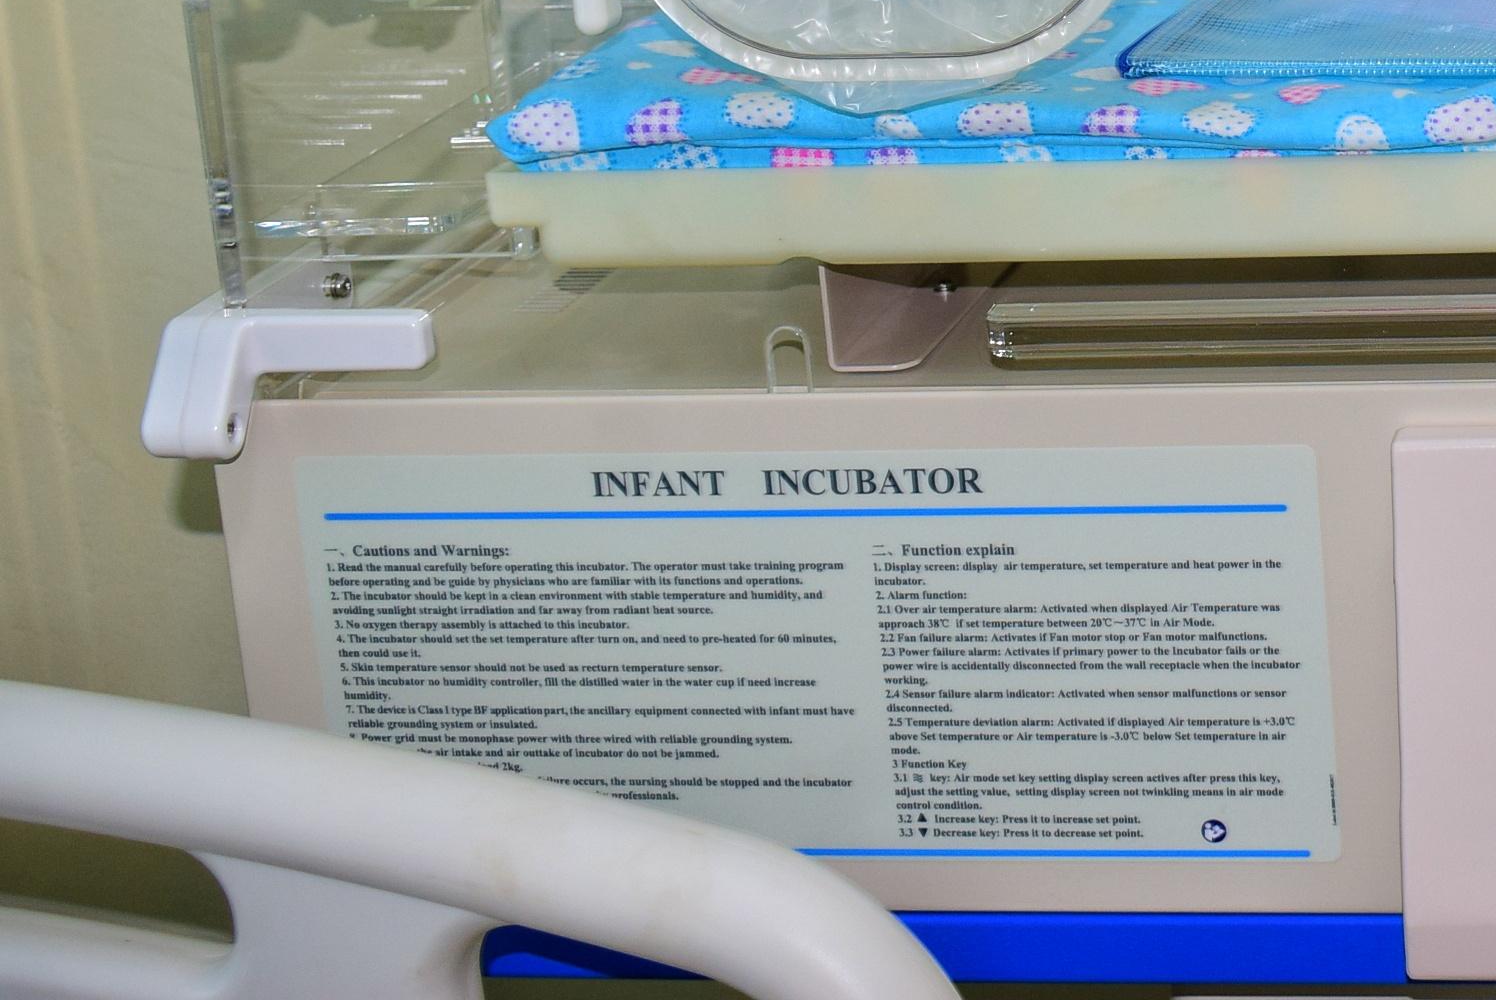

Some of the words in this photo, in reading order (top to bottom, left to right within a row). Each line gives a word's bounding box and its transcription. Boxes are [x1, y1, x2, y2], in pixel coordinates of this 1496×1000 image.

[592, 470, 724, 497] INFANT
[762, 468, 983, 496] INCUBATOR
[353, 545, 411, 557] Cautions
[413, 545, 438, 556] and
[441, 545, 510, 560] Warnings:
[902, 544, 962, 556] Function
[966, 544, 1015, 559] explain
[336, 563, 365, 572] Read
[364, 562, 383, 572] the
[382, 563, 423, 572] manual
[422, 562, 469, 574] carefully
[470, 562, 504, 572] before
[504, 562, 554, 574] operating
[555, 562, 575, 572] this
[576, 562, 629, 572] incubator.
[631, 562, 652, 571] The
[654, 563, 699, 574] operator
[701, 563, 728, 571] must
[729, 561, 752, 570] take
[754, 561, 797, 572] training
[798, 563, 844, 572] program
[884, 562, 922, 574] Display
[962, 562, 998, 573] display
[1004, 562, 1019, 571] air
[1020, 562, 1087, 573] temperature,
[1105, 561, 1169, 572] temperature
[1171, 560, 1191, 569] and
[1193, 560, 1216, 569] heat
[1218, 562, 1250, 571] power
[1265, 560, 1282, 568] the
[874, 577, 926, 586] incubator.
[888, 591, 920, 600] Alarm
[922, 590, 967, 600] function:
[332, 605, 376, 617] avoiding
[376, 605, 418, 617] sunlight
[418, 606, 459, 617] straight
[460, 606, 515, 615] irradiation
[517, 606, 537, 615] and
[538, 606, 554, 615] far
[556, 608, 583, 617] away
[585, 605, 610, 615] from
[613, 605, 650, 614] radiant
[653, 605, 675, 614] heat
[877, 605, 893, 614] 2.1
[894, 605, 921, 614] Over
[922, 605, 938, 614] air
[939, 606, 1002, 616] temperature
[1004, 604, 1037, 613] alarm:
[1041, 604, 1088, 613] Activated
[1091, 604, 1118, 613] when
[1120, 603, 1170, 615] displayed
[1171, 603, 1189, 613] Air
[1191, 603, 1259, 615] Temperature
[361, 622, 398, 632] oxygen
[398, 620, 439, 632] therapy
[441, 620, 486, 632] assembly
[498, 620, 542, 629] attached
[556, 620, 576, 629] this
[577, 620, 630, 629] incubator.
[880, 633, 896, 643] 2.2
[897, 633, 917, 643] Fan
[919, 633, 953, 642] failure
[954, 633, 988, 642] alarm:
[991, 633, 1037, 642] Activates
[1049, 633, 1069, 642] Fan
[1104, 634, 1126, 644] stop
[1142, 632, 1163, 641] Fan
[1165, 633, 1197, 641] motor
[1198, 632, 1268, 641] malfunctions.
[350, 662, 375, 672] Skin
[375, 664, 439, 674] temperature
[474, 663, 508, 672] should
[543, 663, 566, 672] used
[622, 664, 685, 675] temperature
[884, 676, 928, 687] working.
[344, 691, 391, 702] humidity.
[885, 690, 901, 699] 2.4
[902, 689, 937, 699] Sensor
[938, 689, 972, 699] failure
[974, 689, 1004, 698] alarm
[1006, 689, 1055, 698] indicator:
[1058, 689, 1106, 698] Activated
[1108, 689, 1135, 698] when
[1172, 688, 1238, 698] malfunctions
[886, 704, 953, 712] disconnected.
[348, 719, 385, 728] reliable
[387, 719, 440, 731] grounding
[440, 721, 474, 731] system
[490, 720, 538, 729] insulated.
[890, 746, 921, 755] mode.
[901, 759, 945, 769] Function
[948, 760, 967, 771] Key
[896, 801, 932, 810] control
[933, 801, 983, 810] condition.
